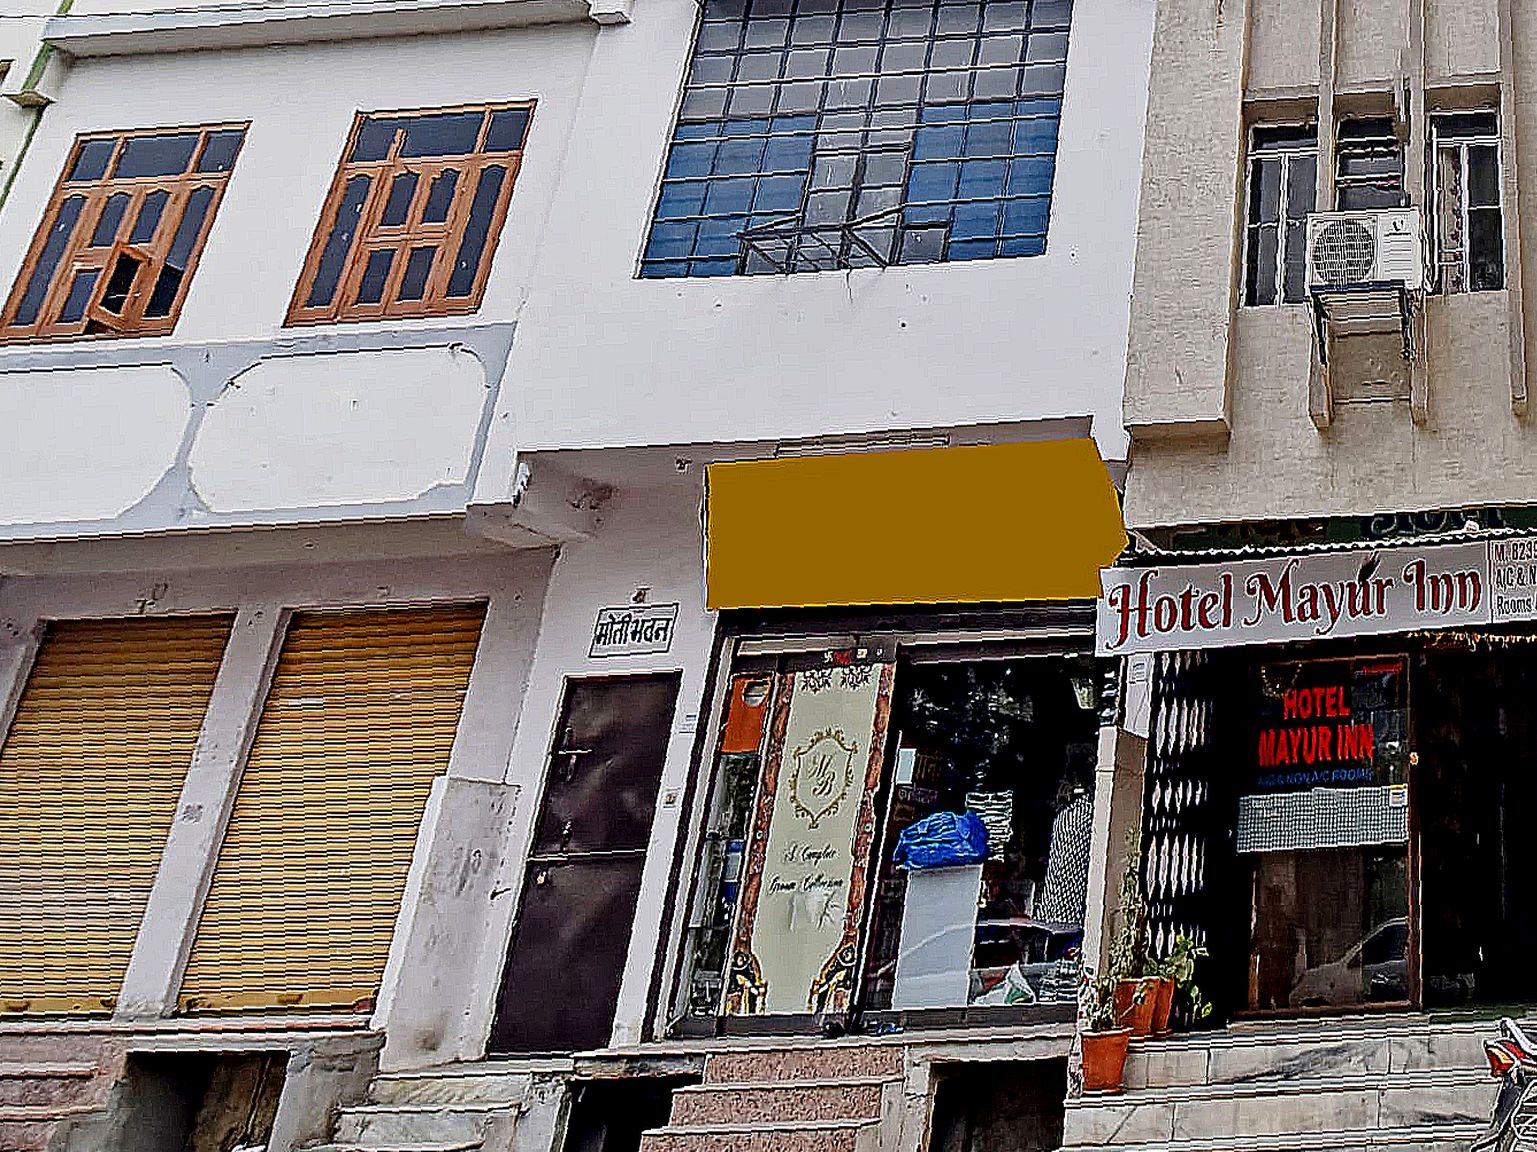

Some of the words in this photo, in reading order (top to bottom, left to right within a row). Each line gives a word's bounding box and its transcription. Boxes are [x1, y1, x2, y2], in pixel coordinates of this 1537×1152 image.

[1496, 567, 1514, 590] A/C
[1516, 567, 1526, 587] &
[1105, 570, 1233, 650] Hotel
[1243, 555, 1394, 635] Mayur
[1403, 559, 1482, 614] Inn
[1497, 595, 1532, 615] Rooms
[1284, 686, 1351, 720] HOTEL
[1259, 726, 1332, 766] MAYUR
[1338, 724, 1374, 762] INN
